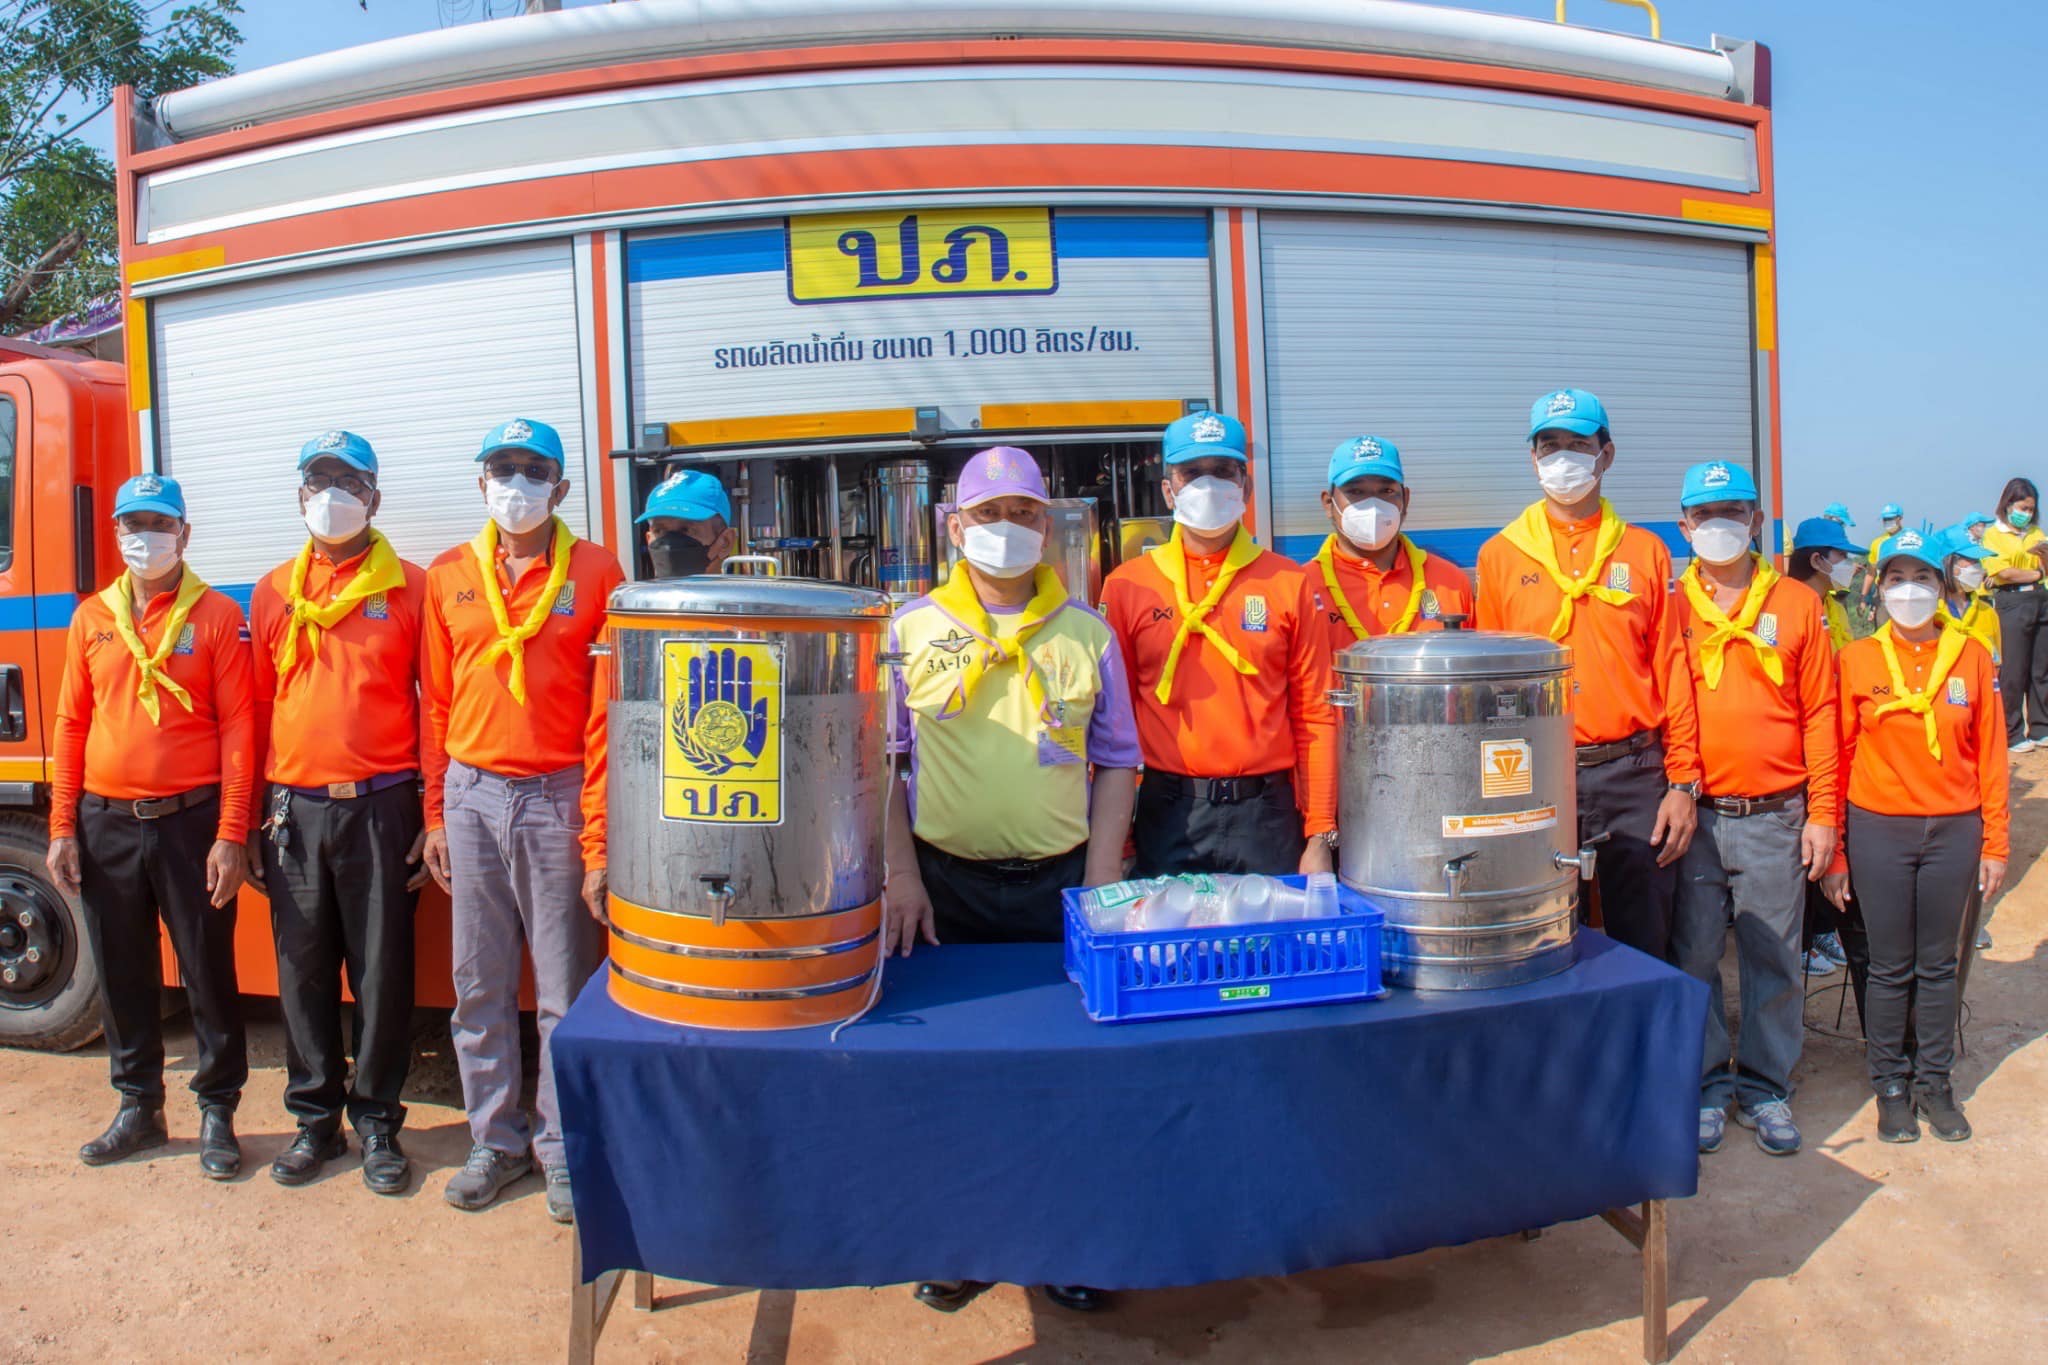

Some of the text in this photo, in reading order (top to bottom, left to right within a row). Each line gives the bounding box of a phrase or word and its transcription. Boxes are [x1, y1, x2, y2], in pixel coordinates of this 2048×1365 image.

[837, 214, 1029, 289] ปภ.
[714, 325, 1140, 370] รถผลิตน้ำดื่ม ขนาด 1,000 ลิตร/ชม.
[926, 654, 972, 674] 3A-19
[682, 783, 768, 818] ปภ.
